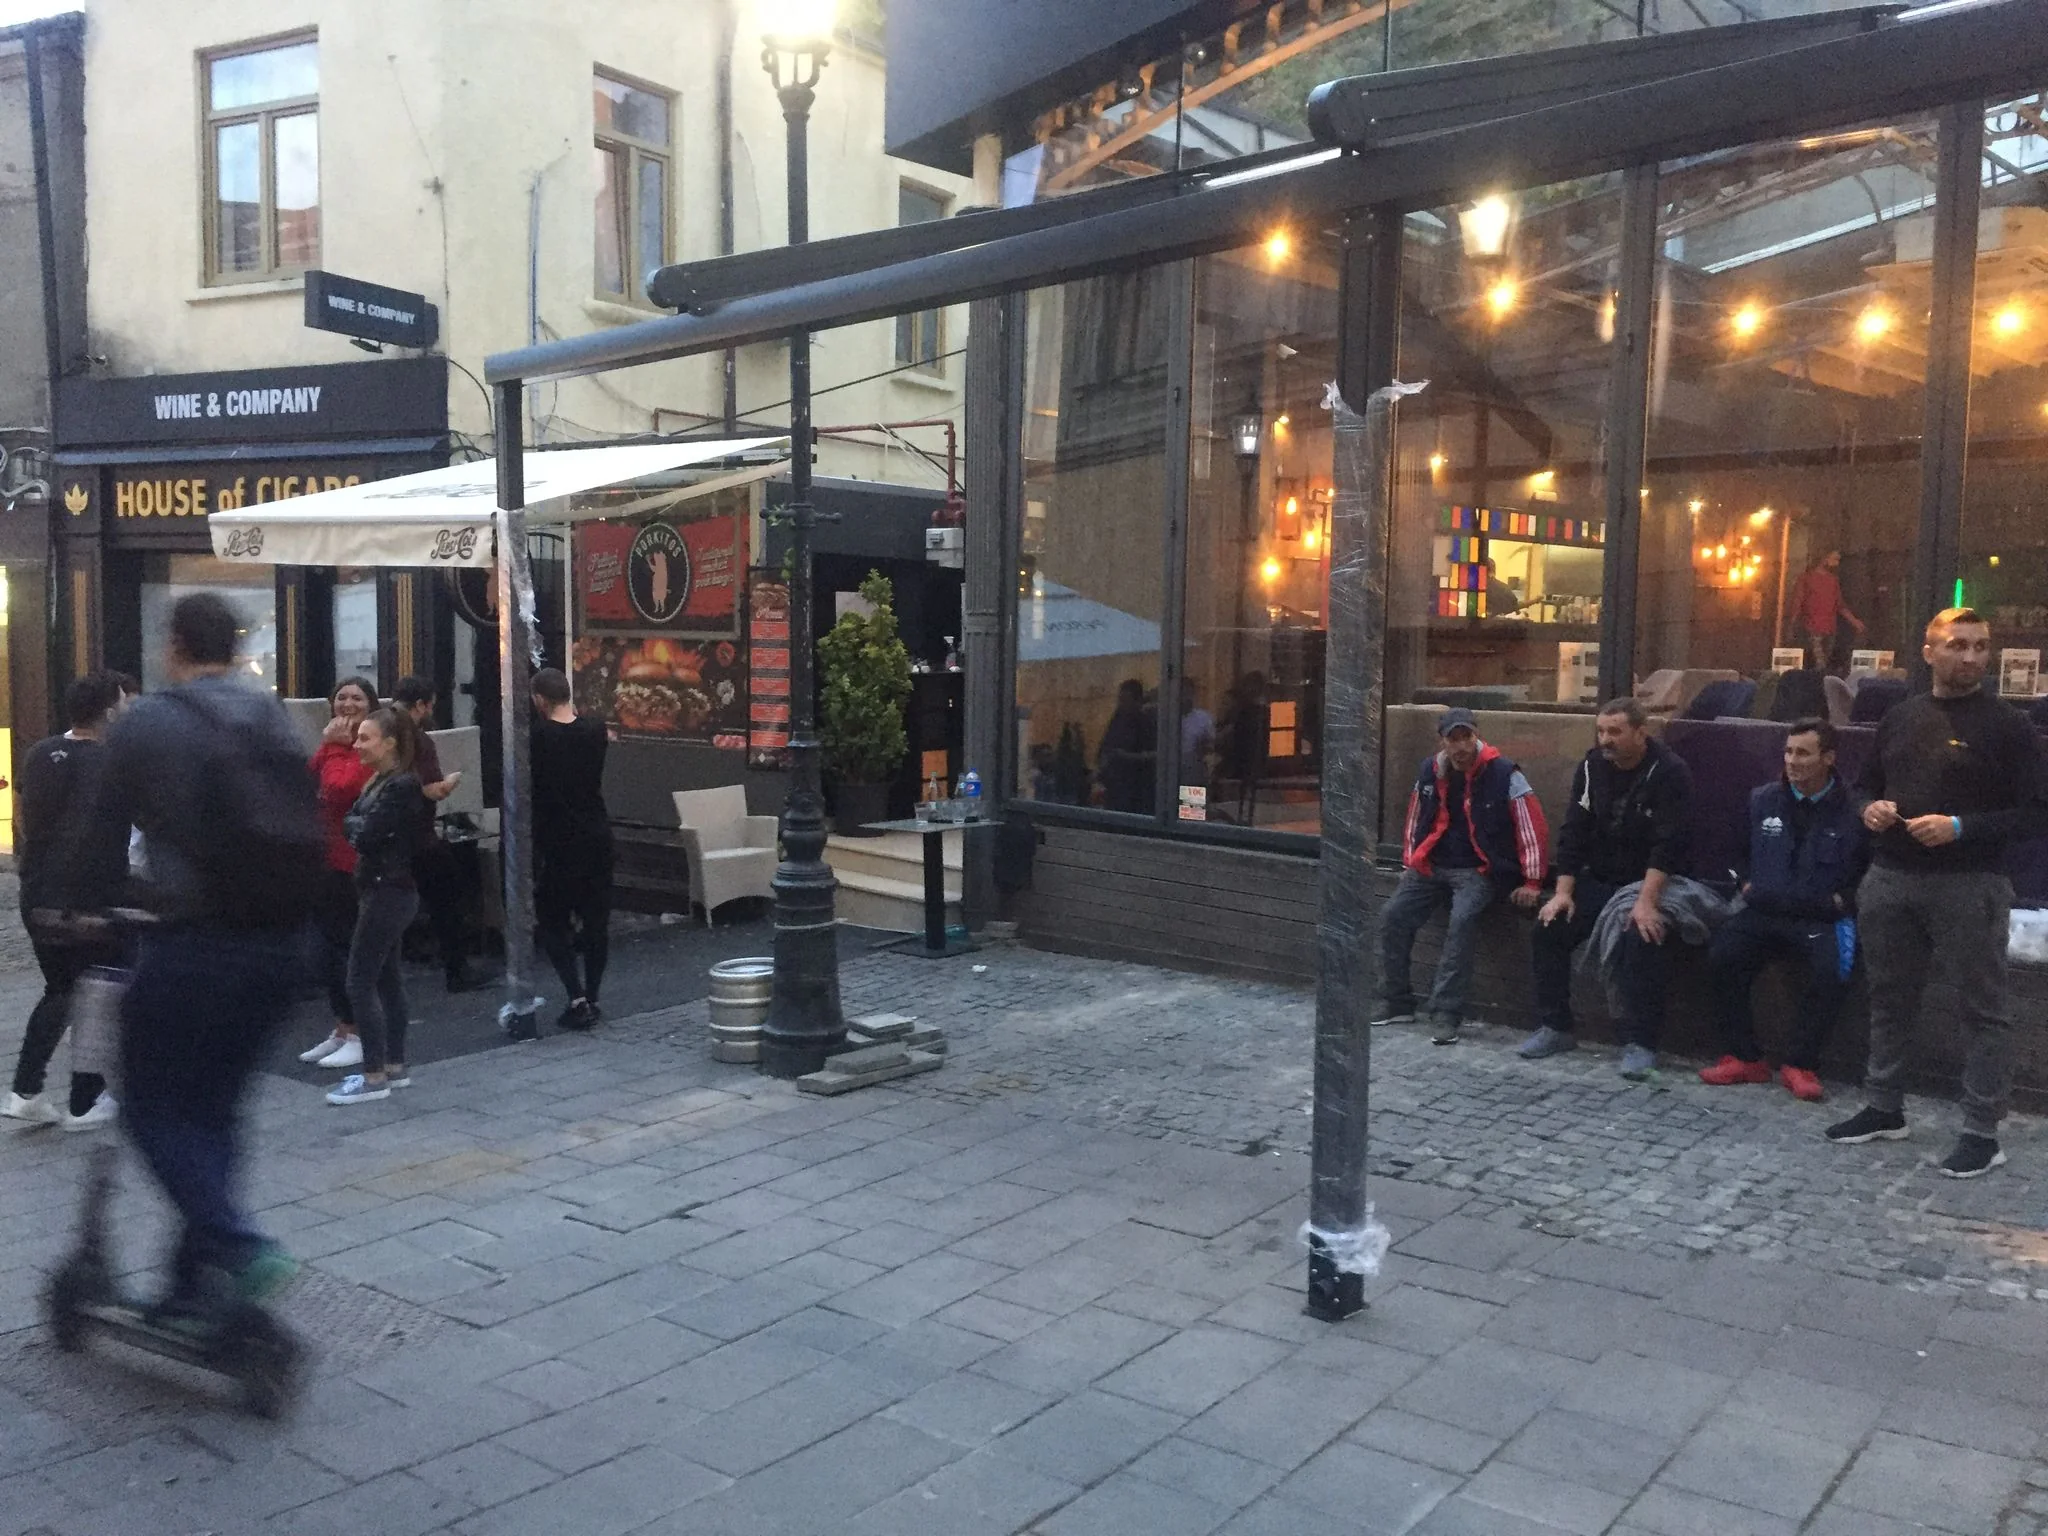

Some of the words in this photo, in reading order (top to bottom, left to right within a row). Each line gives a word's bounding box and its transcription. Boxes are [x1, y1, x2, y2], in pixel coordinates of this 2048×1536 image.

[328, 295, 355, 312] WINE
[357, 301, 366, 315] &
[367, 303, 415, 325] COMPANY
[154, 393, 202, 420] WINE
[206, 392, 221, 418] &
[226, 386, 321, 417] COMPANY
[116, 479, 208, 518] HOUSE
[217, 476, 246, 511] of
[635, 531, 682, 558] PORKITOS
